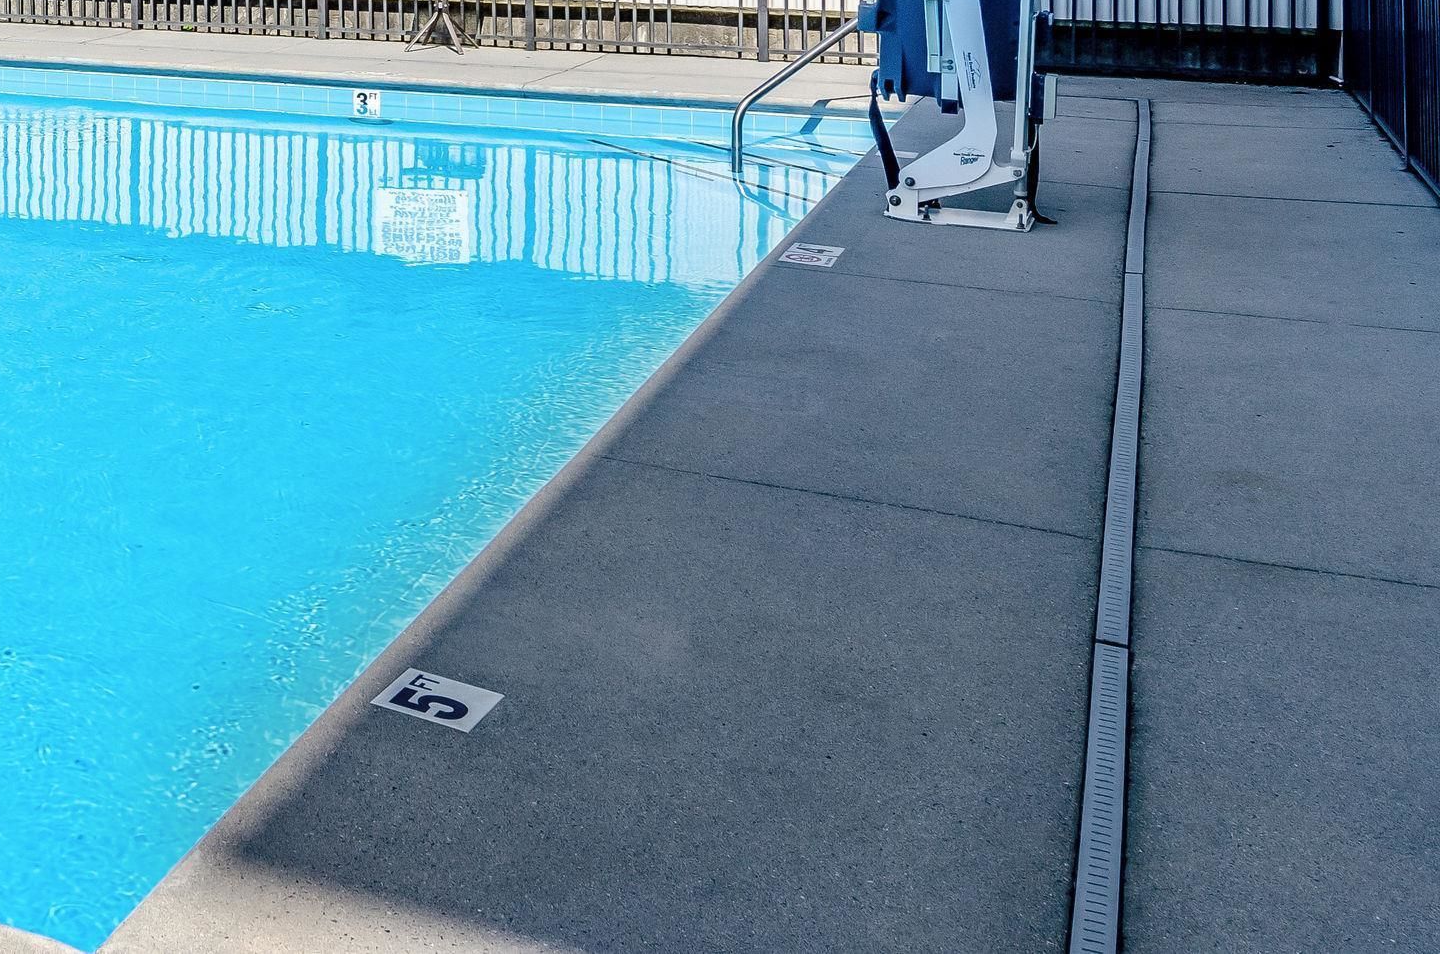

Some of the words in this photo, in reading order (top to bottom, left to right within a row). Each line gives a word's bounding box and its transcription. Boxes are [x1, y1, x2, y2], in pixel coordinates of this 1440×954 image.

[356, 92, 368, 112] 3
[369, 92, 378, 100] FT
[408, 674, 441, 692] FT
[389, 686, 469, 720] 5
